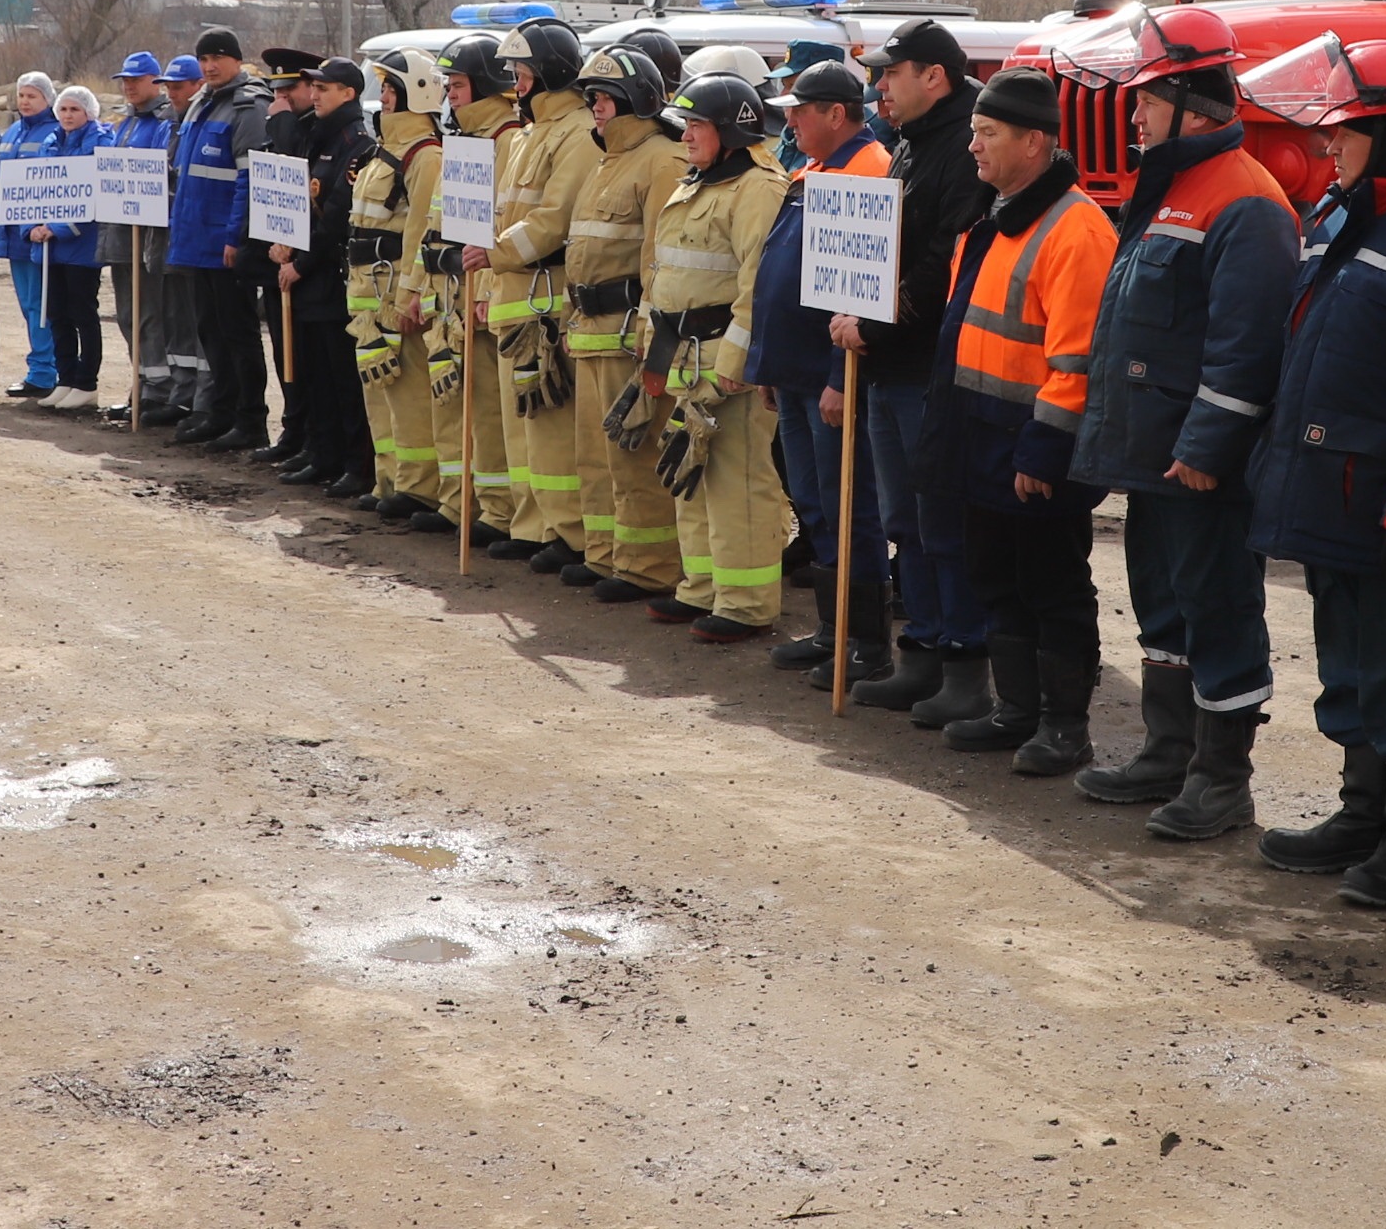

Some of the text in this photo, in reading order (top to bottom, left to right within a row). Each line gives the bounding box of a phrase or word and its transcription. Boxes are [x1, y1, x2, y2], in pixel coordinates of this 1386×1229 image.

[596, 61, 610, 72] 44
[25, 165, 68, 180] ГРУППА
[252, 161, 306, 187] ГРУППА ОХРАНЫ
[2, 184, 93, 202] МЕДИЦИНСКОГО
[100, 179, 163, 196] КОМАНДА ПО ГАЗОВЫМ
[122, 200, 140, 216] СЕТЯМ
[252, 186, 307, 213] ОБЩЕСТВЕННОГО
[807, 187, 894, 222] КОМАНДА ПО РЕМОНТУ
[5, 205, 86, 221] ОБЕСПЕЧЕНИЯ
[266, 214, 295, 237] ПОРЯДКА
[809, 226, 888, 263] И ВОССТАНОВЛЕНИЮ
[814, 265, 880, 302] ДОРОГ И МОСТОВ
